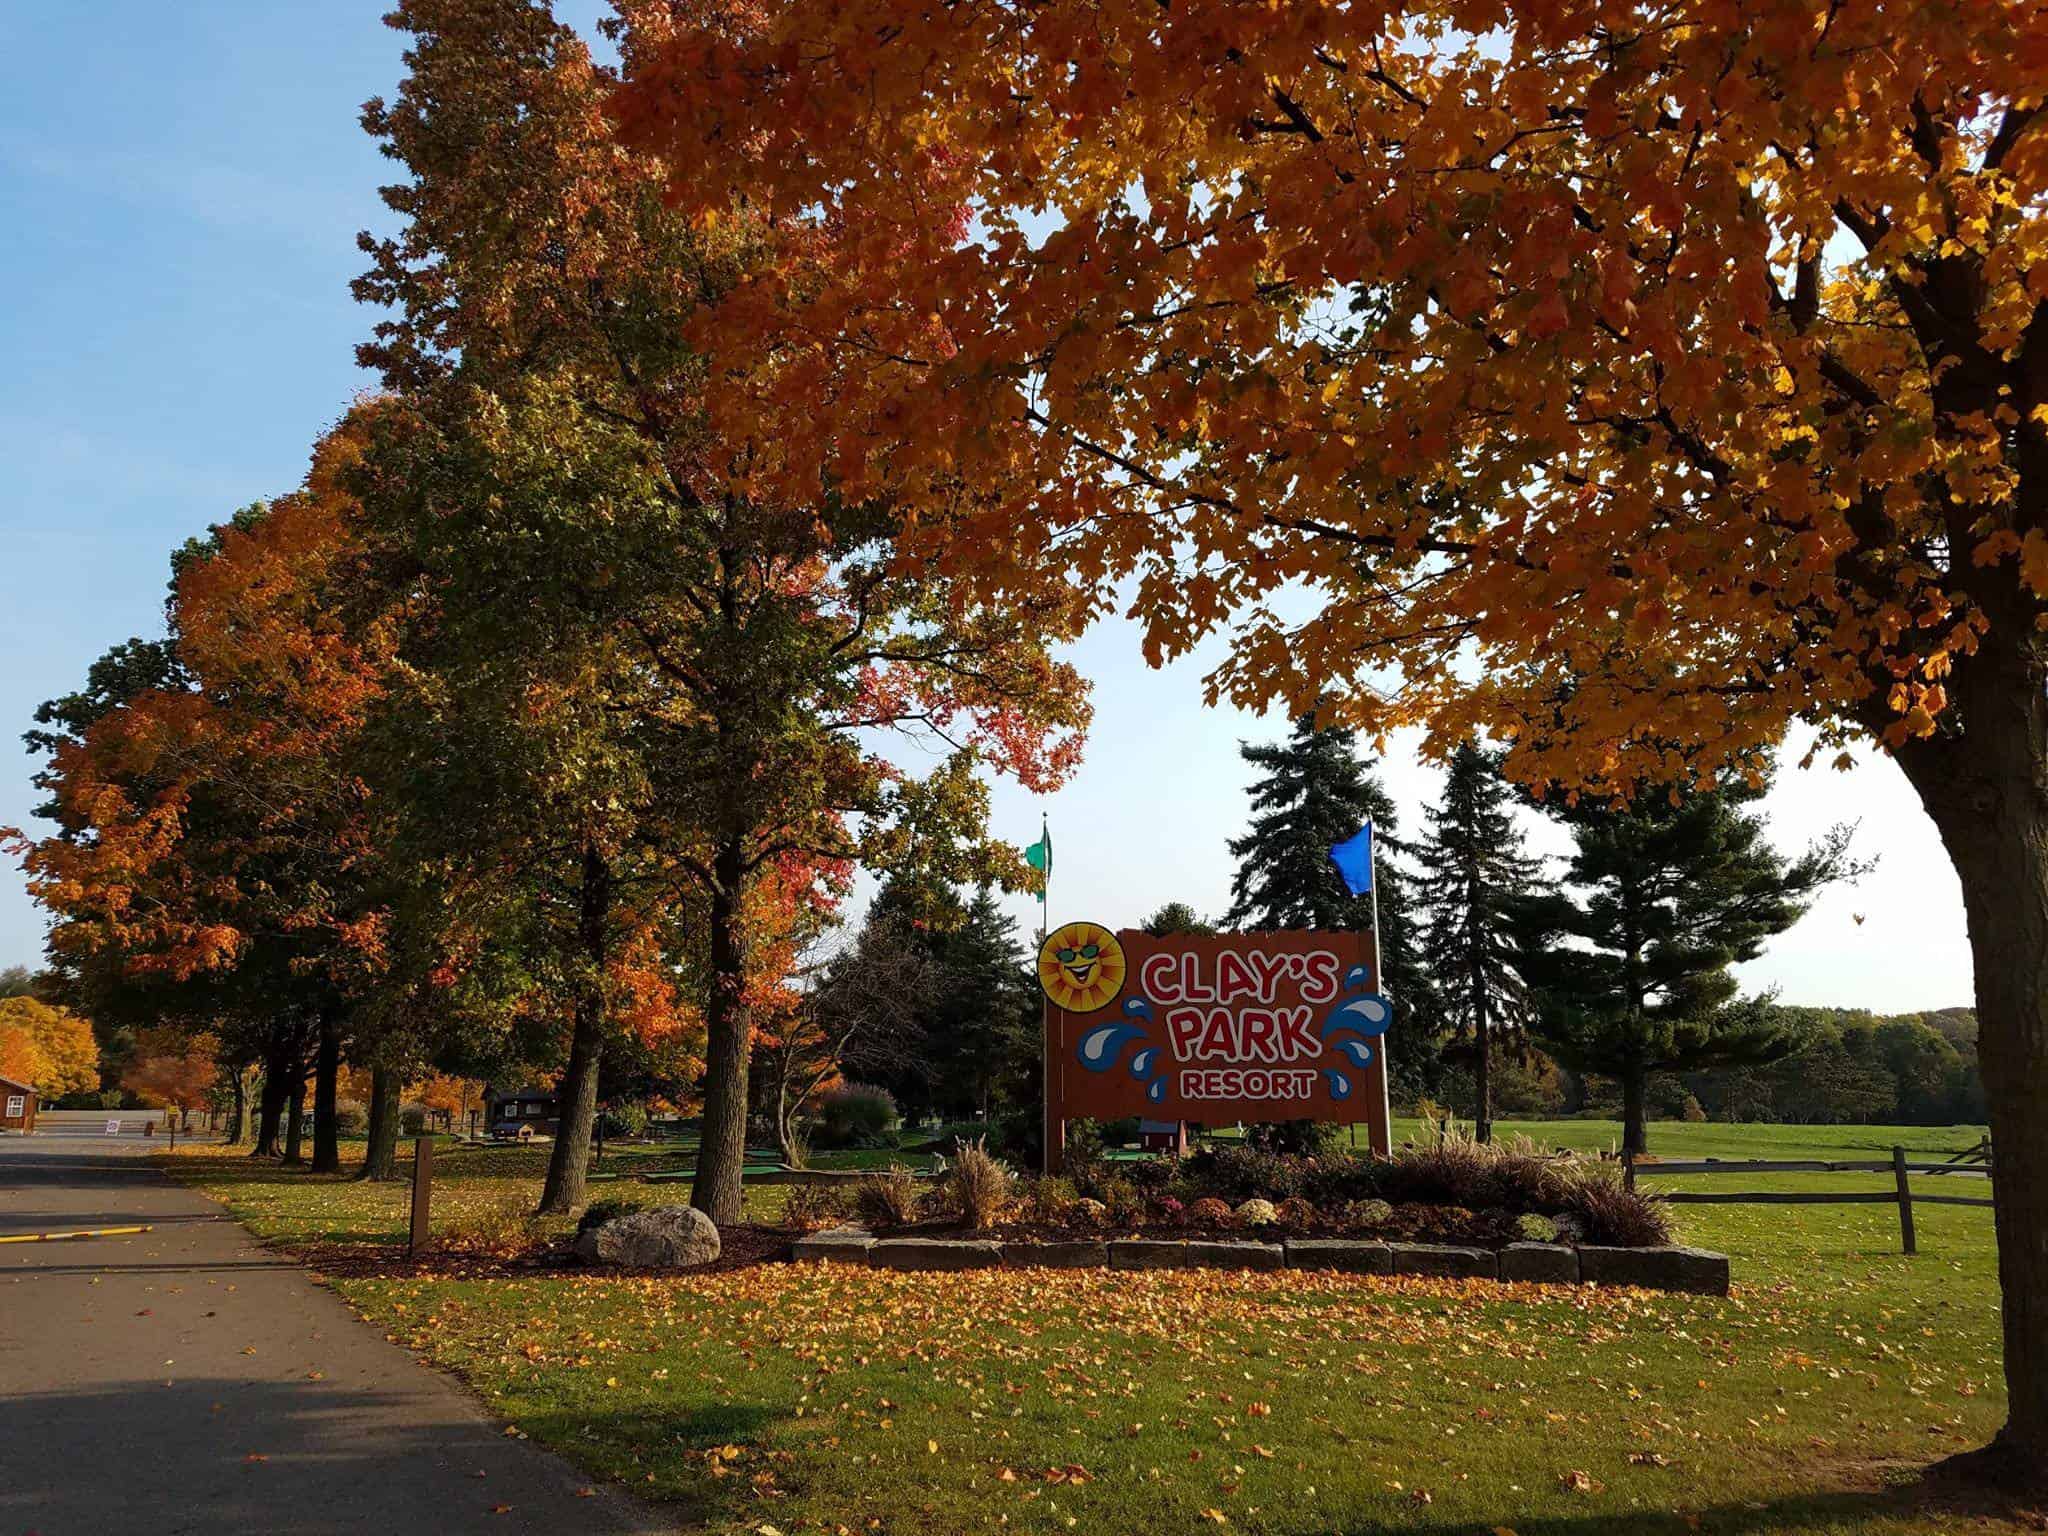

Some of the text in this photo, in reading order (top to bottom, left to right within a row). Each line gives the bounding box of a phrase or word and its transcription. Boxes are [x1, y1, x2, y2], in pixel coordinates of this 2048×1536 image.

[1142, 951, 1340, 1005] CLAY'S
[1168, 1006, 1322, 1062] PARK
[1180, 1070, 1316, 1099] RESORT
